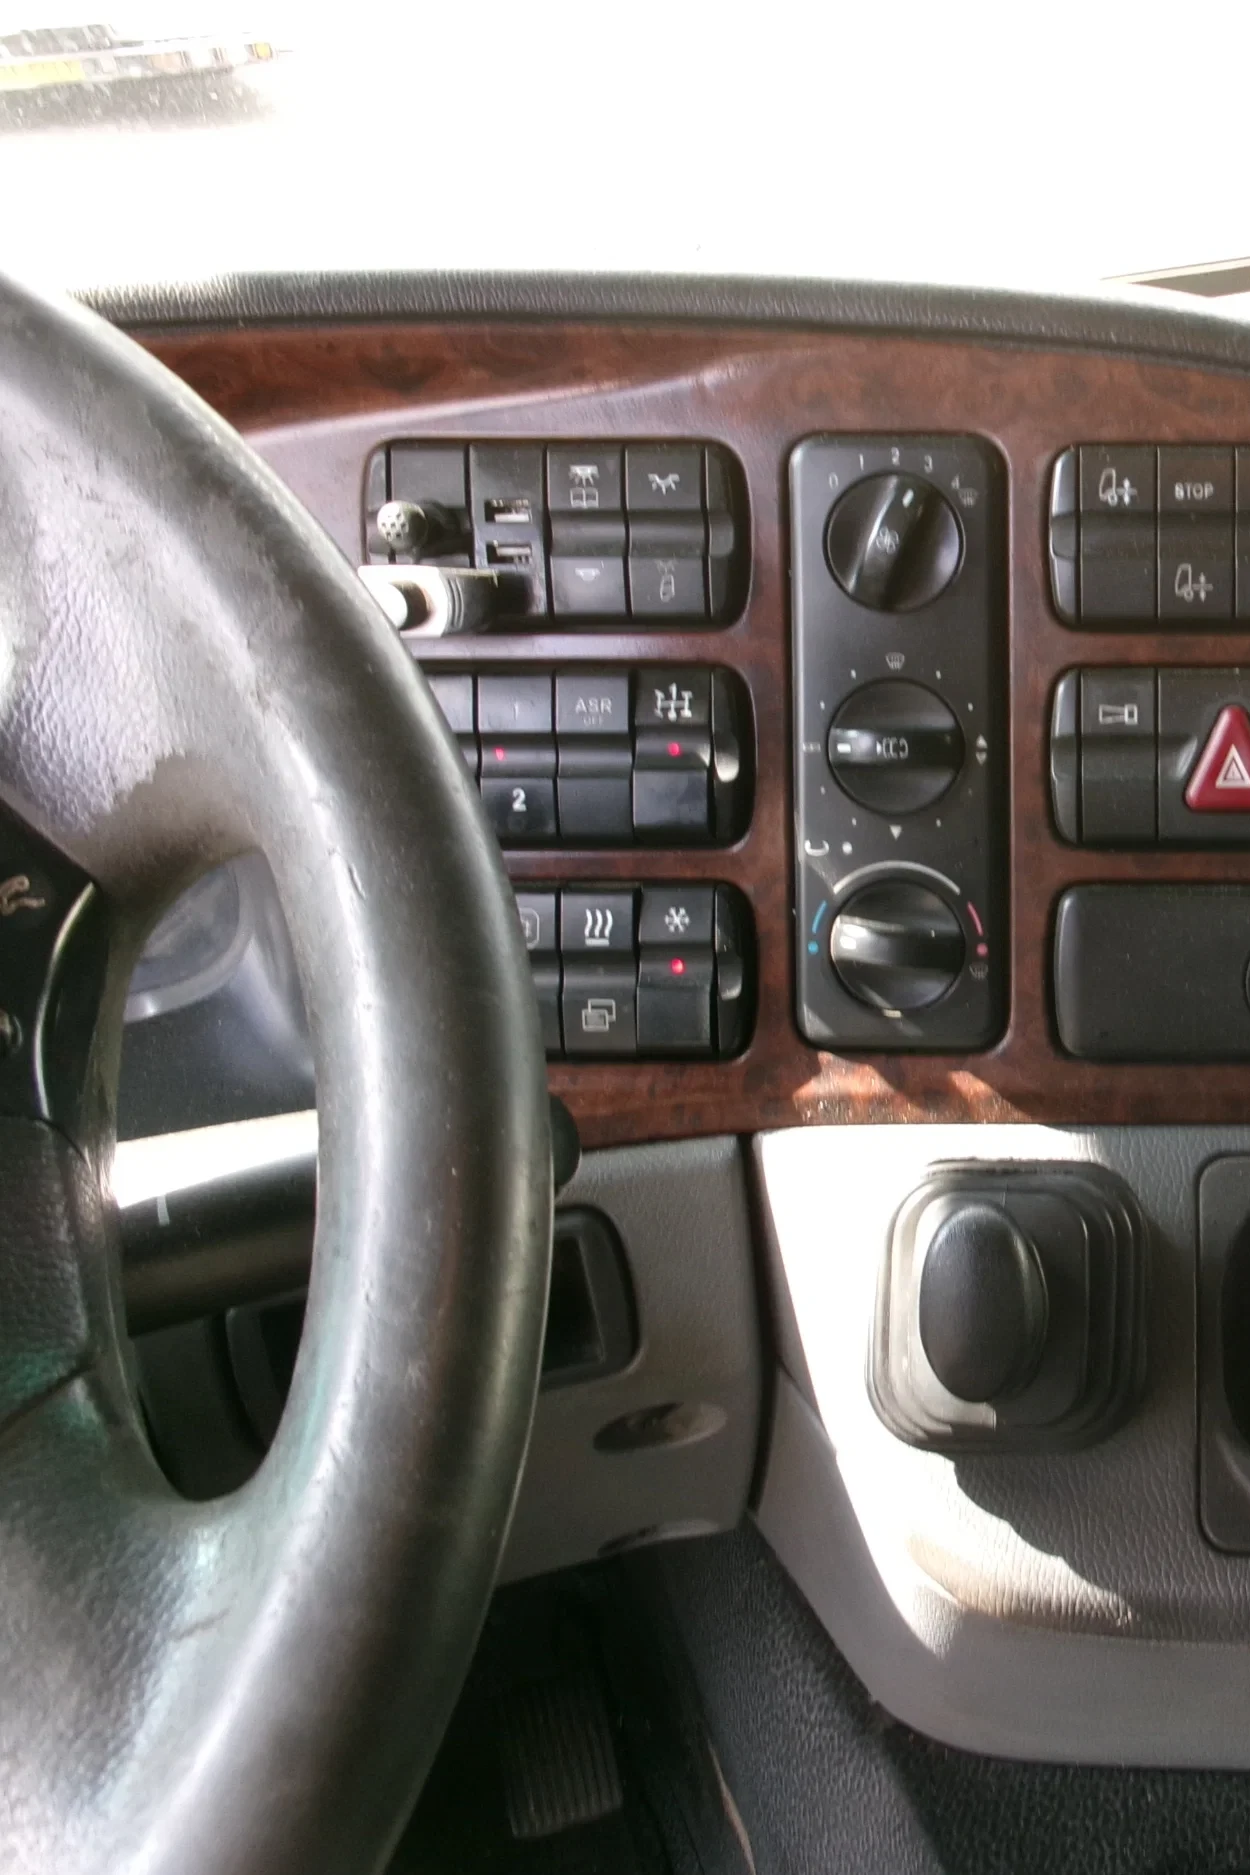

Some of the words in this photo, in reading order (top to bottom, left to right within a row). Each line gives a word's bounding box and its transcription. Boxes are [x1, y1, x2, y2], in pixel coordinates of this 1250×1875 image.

[829, 473, 838, 489] 0
[859, 454, 864, 470] 1
[891, 447, 900, 465] 2
[924, 455, 933, 473] 3
[1174, 481, 1214, 500] STOP
[575, 696, 613, 714] ASR
[512, 787, 527, 812] 2
